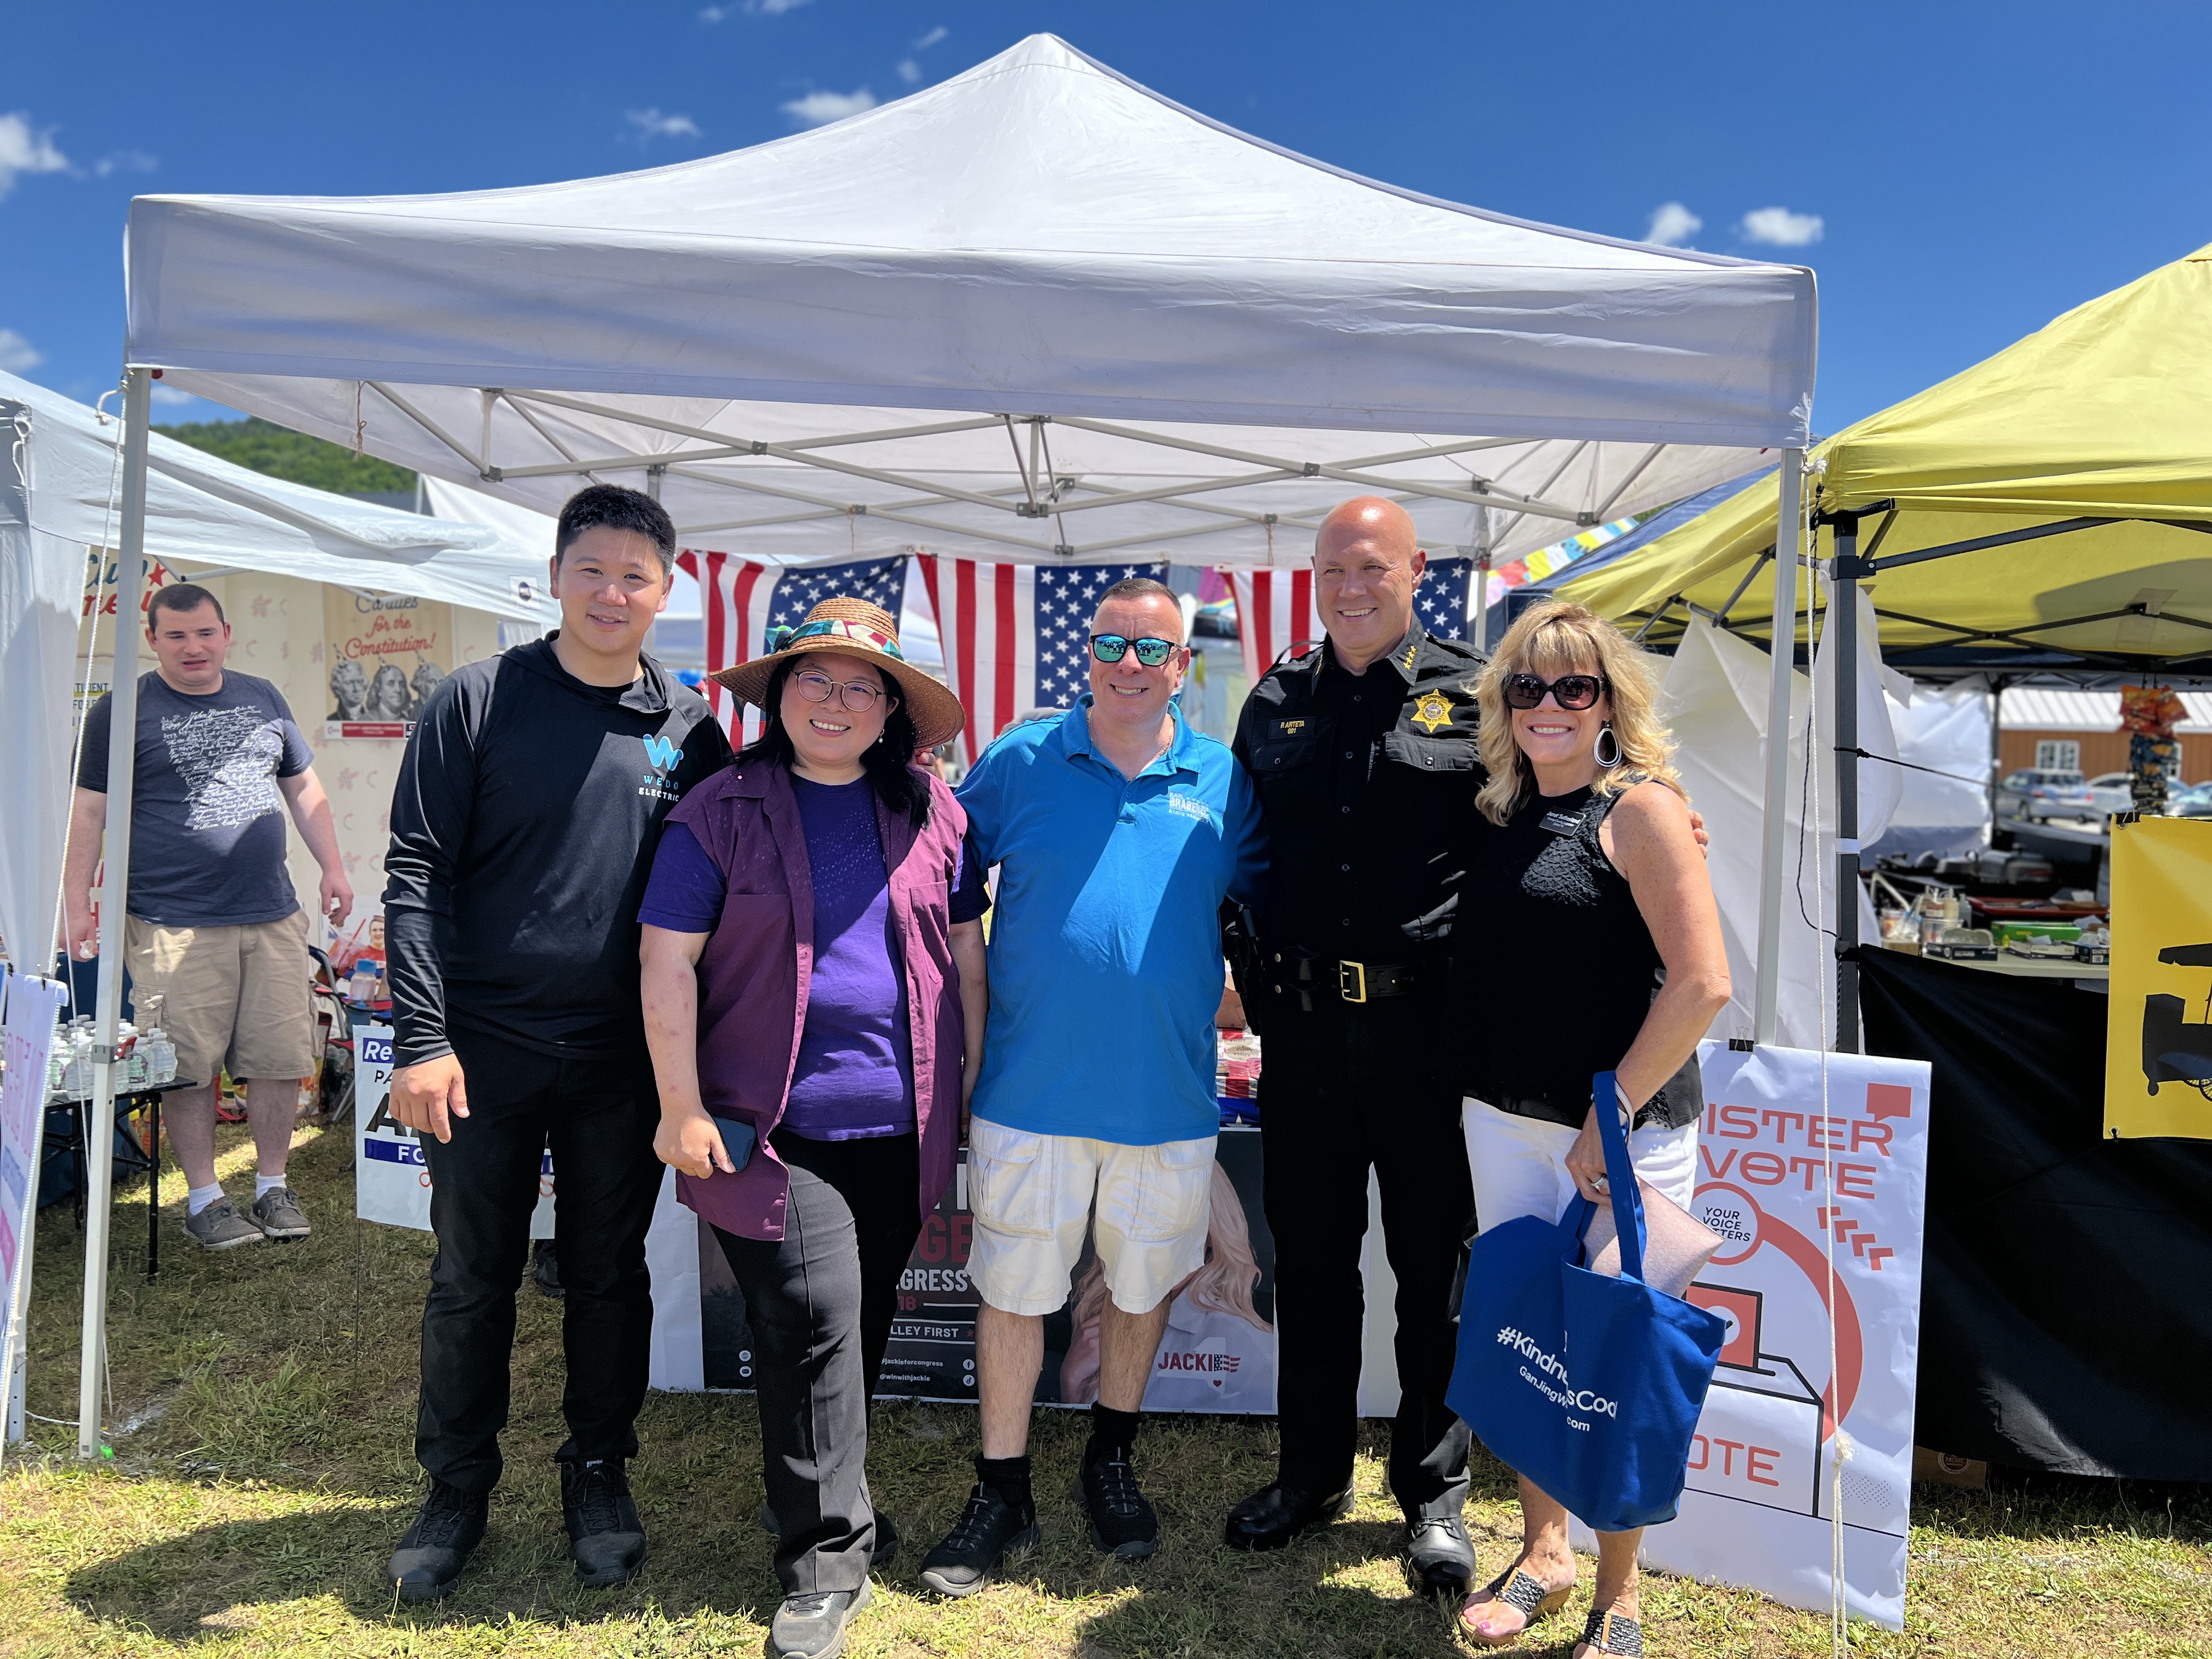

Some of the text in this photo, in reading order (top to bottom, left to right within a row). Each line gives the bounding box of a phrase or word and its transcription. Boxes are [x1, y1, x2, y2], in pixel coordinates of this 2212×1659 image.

[365, 613, 410, 638] for the
[345, 632, 436, 659] Constitution!
[638, 787, 680, 802] ELECTRIC
[1169, 791, 1183, 799] KARL
[1698, 1103, 1894, 1157] ISTER
[1706, 1206, 1740, 1220] YOUR
[1703, 1216, 1741, 1230] VOICE
[896, 1268, 968, 1292] GRESS
[890, 1325, 959, 1338] LLEY FIRST
[1688, 1434, 1781, 1487] OTE
